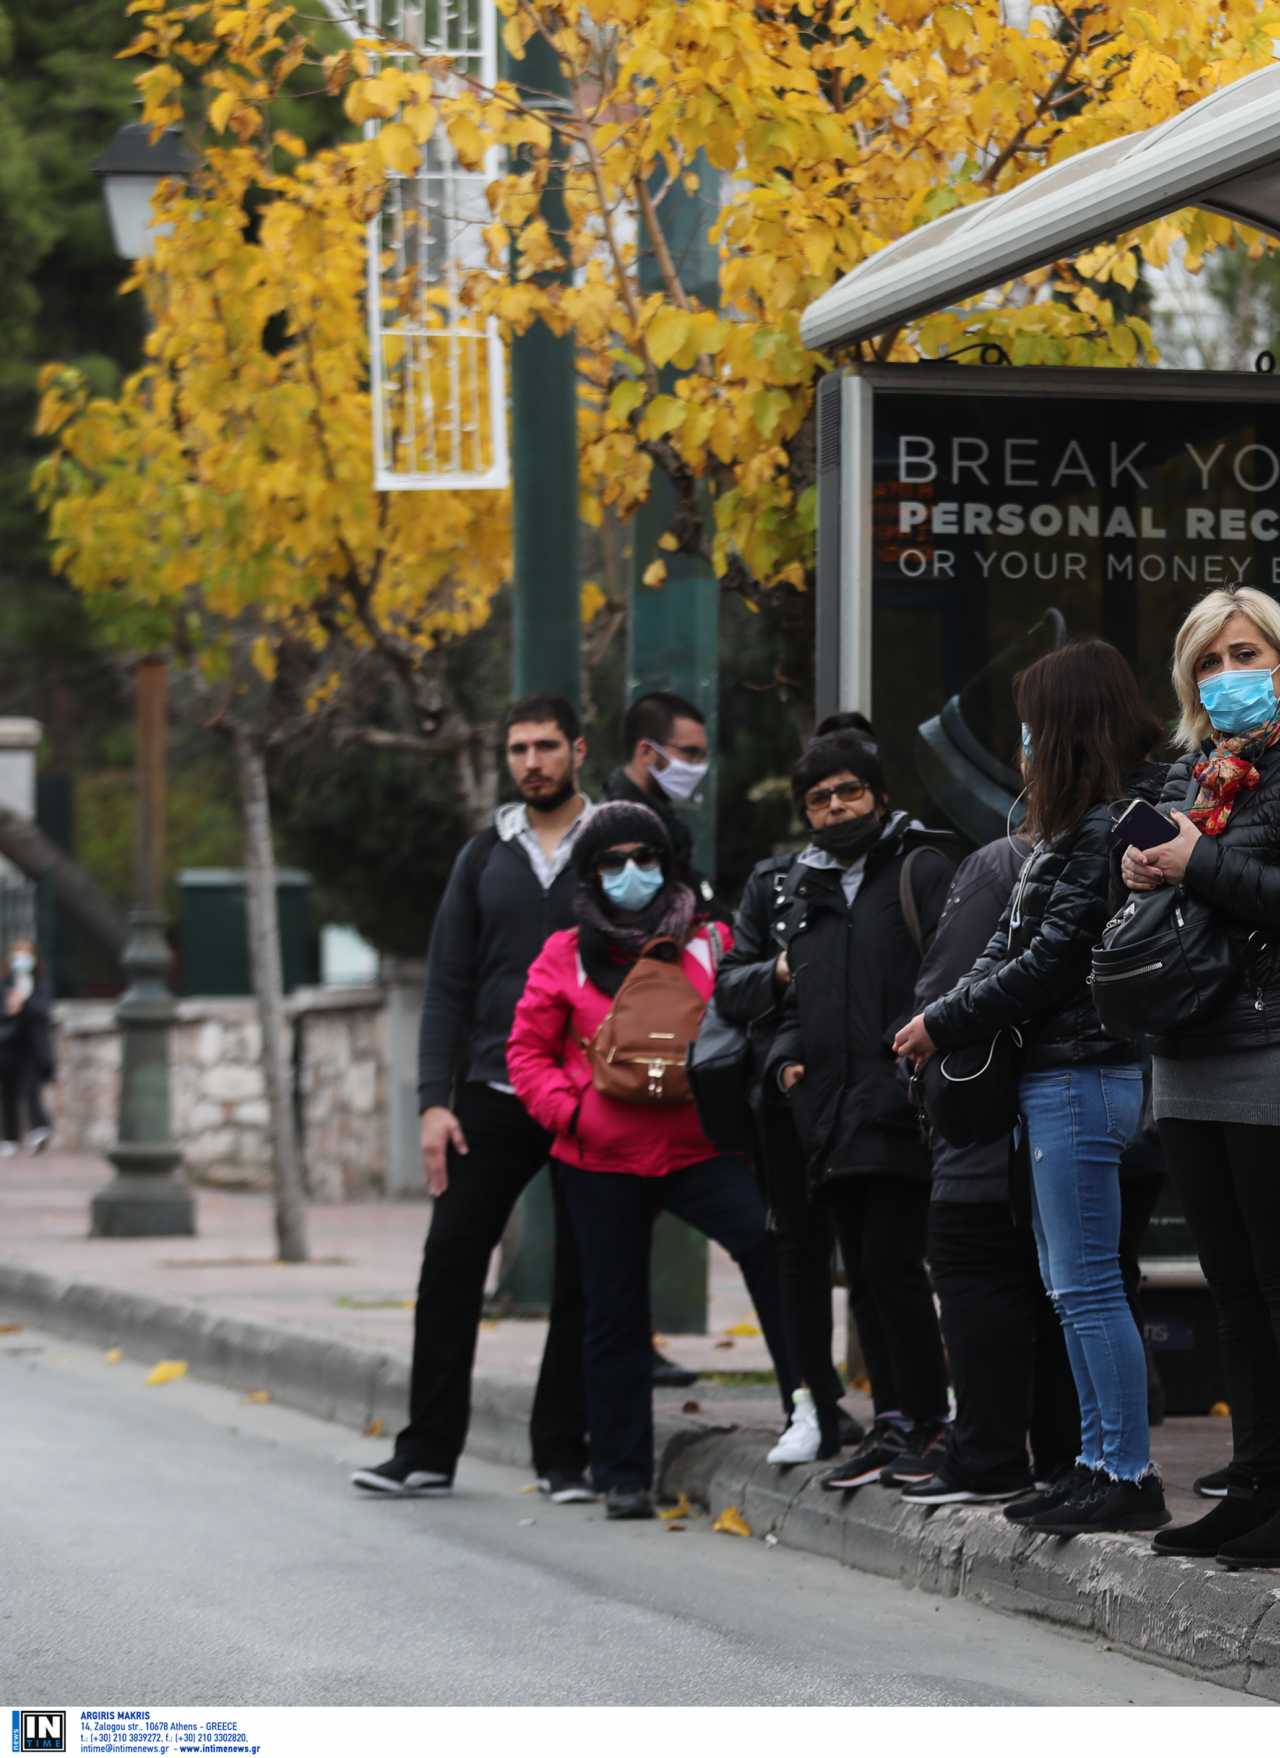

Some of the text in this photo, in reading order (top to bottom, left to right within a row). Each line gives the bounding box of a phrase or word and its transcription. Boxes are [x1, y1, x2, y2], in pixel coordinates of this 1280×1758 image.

[899, 435, 1149, 489] BREAK
[899, 501, 1167, 538] PERSONAL
[899, 549, 955, 578] OR
[974, 551, 1087, 580] YOUR
[1106, 553, 1253, 583] MONEY
